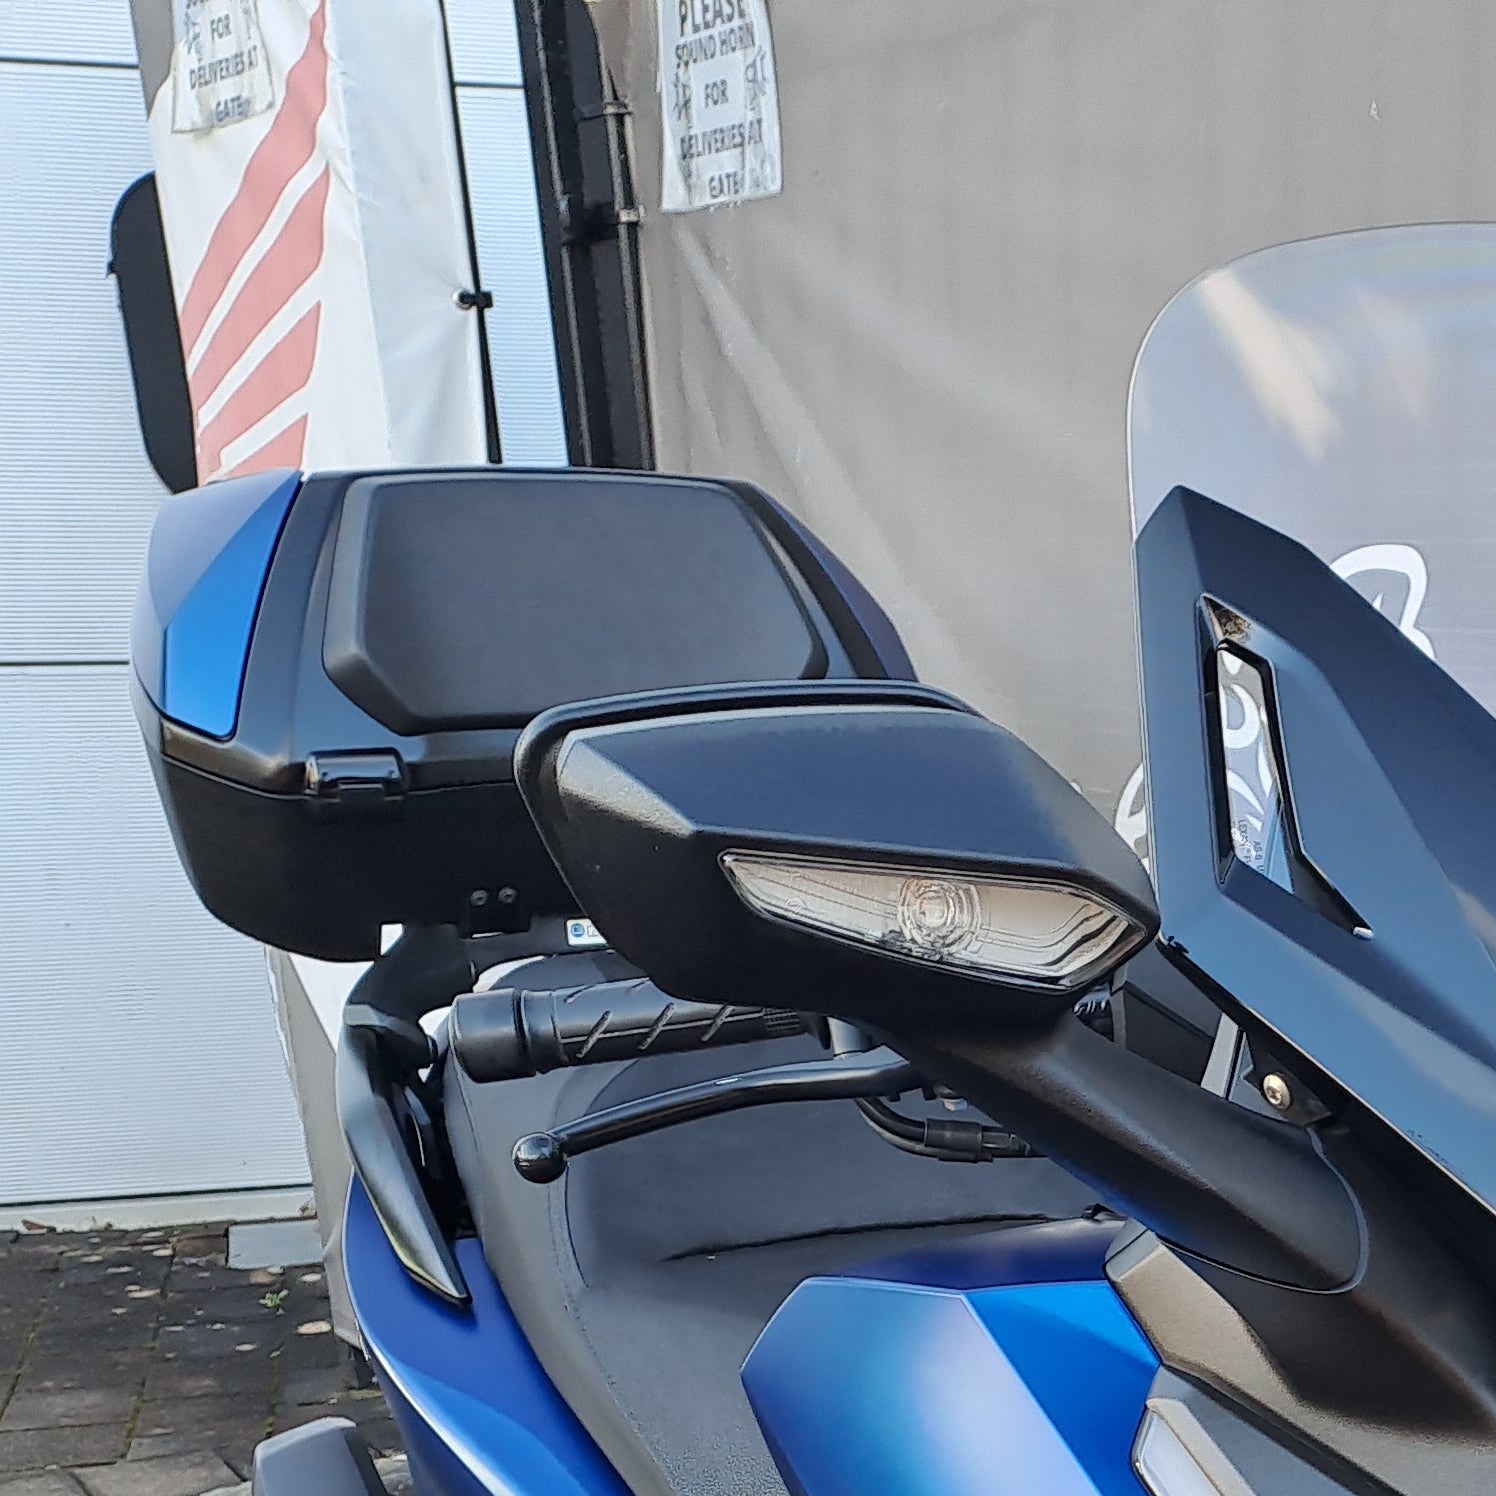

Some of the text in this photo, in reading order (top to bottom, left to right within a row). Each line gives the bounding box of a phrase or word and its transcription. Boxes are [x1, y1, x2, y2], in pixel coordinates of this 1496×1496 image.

[210, 13, 231, 41] FOR
[189, 51, 245, 90] DELIVERIES
[704, 79, 728, 109] FOR
[680, 123, 745, 161] DELIVERIES
[708, 171, 740, 198] GATE
